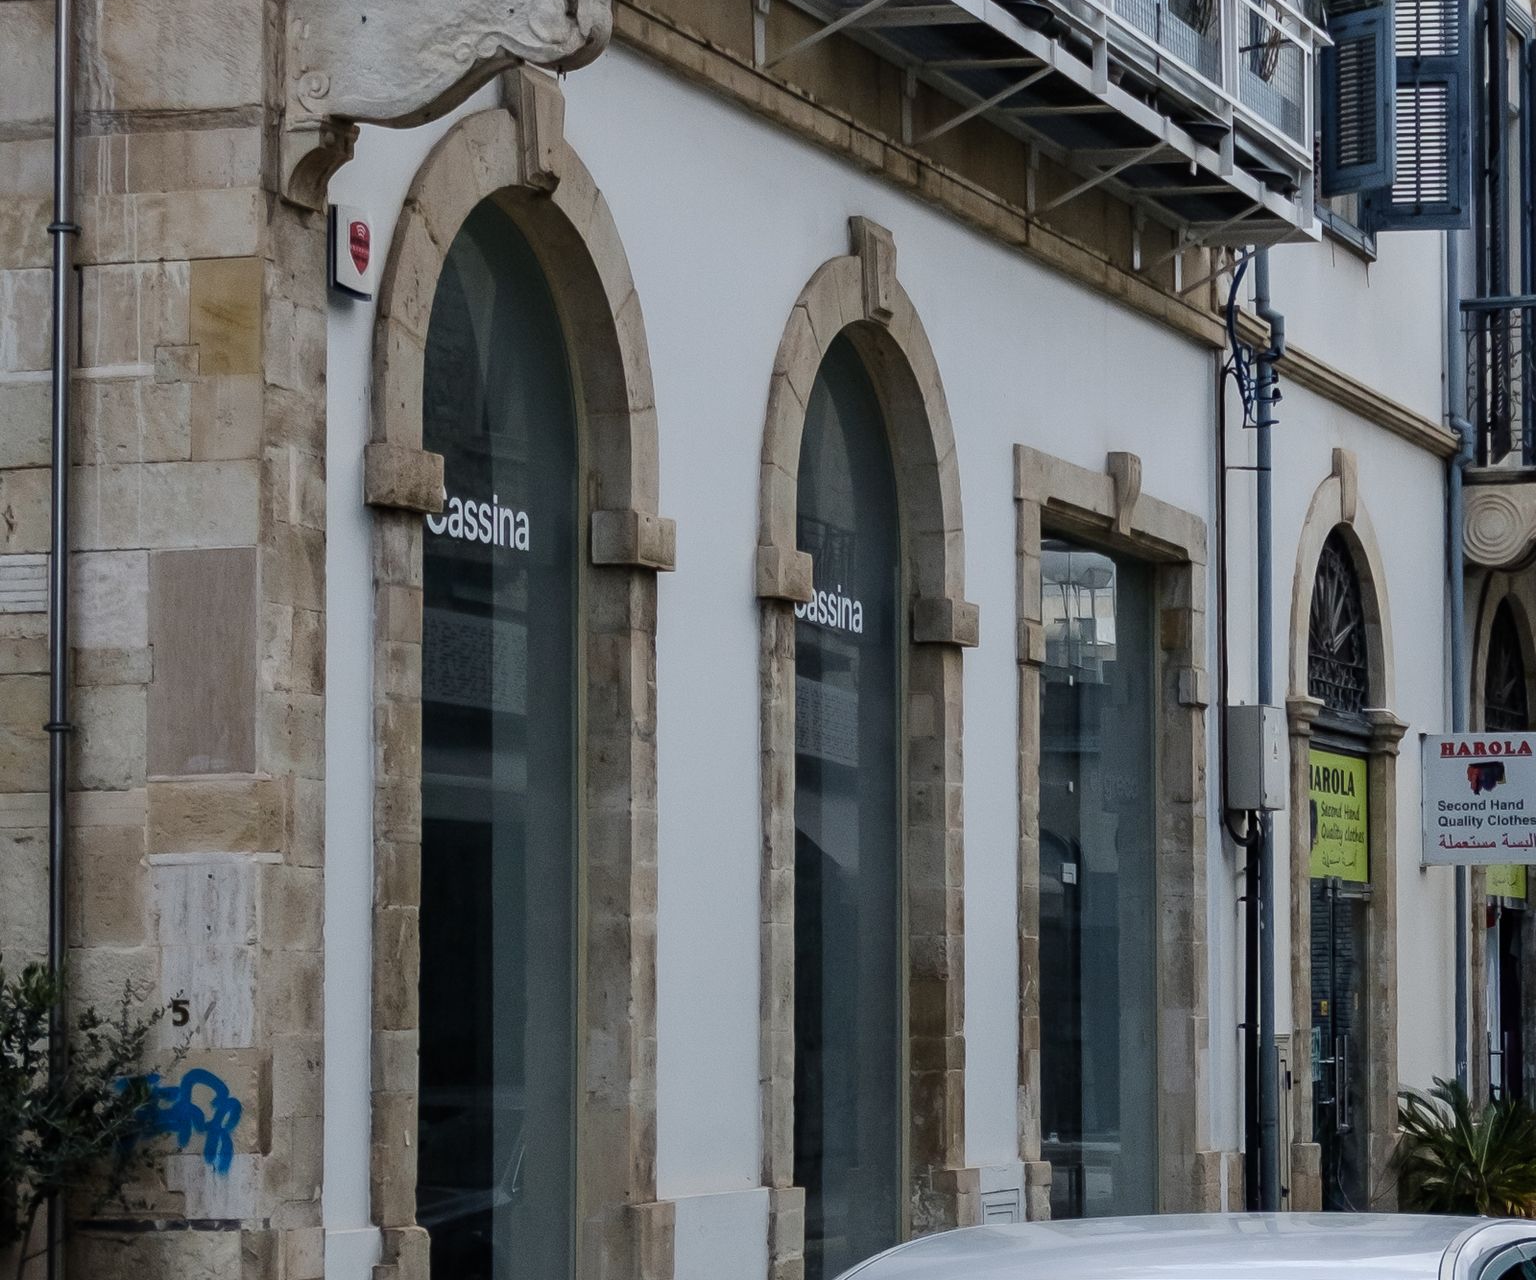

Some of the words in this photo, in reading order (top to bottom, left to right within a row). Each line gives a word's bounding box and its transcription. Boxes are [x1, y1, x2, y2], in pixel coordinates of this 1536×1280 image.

[1440, 740, 1533, 757] HAROLA
[1321, 801, 1342, 818] Second
[1344, 804, 1360, 821] Hand
[1438, 800, 1486, 811] Second
[1490, 799, 1524, 810] Hand
[1438, 816, 1483, 828] Quality
[1487, 815, 1536, 826] Clothes
[1321, 823, 1342, 846] Quality
[172, 999, 190, 1027] 5
